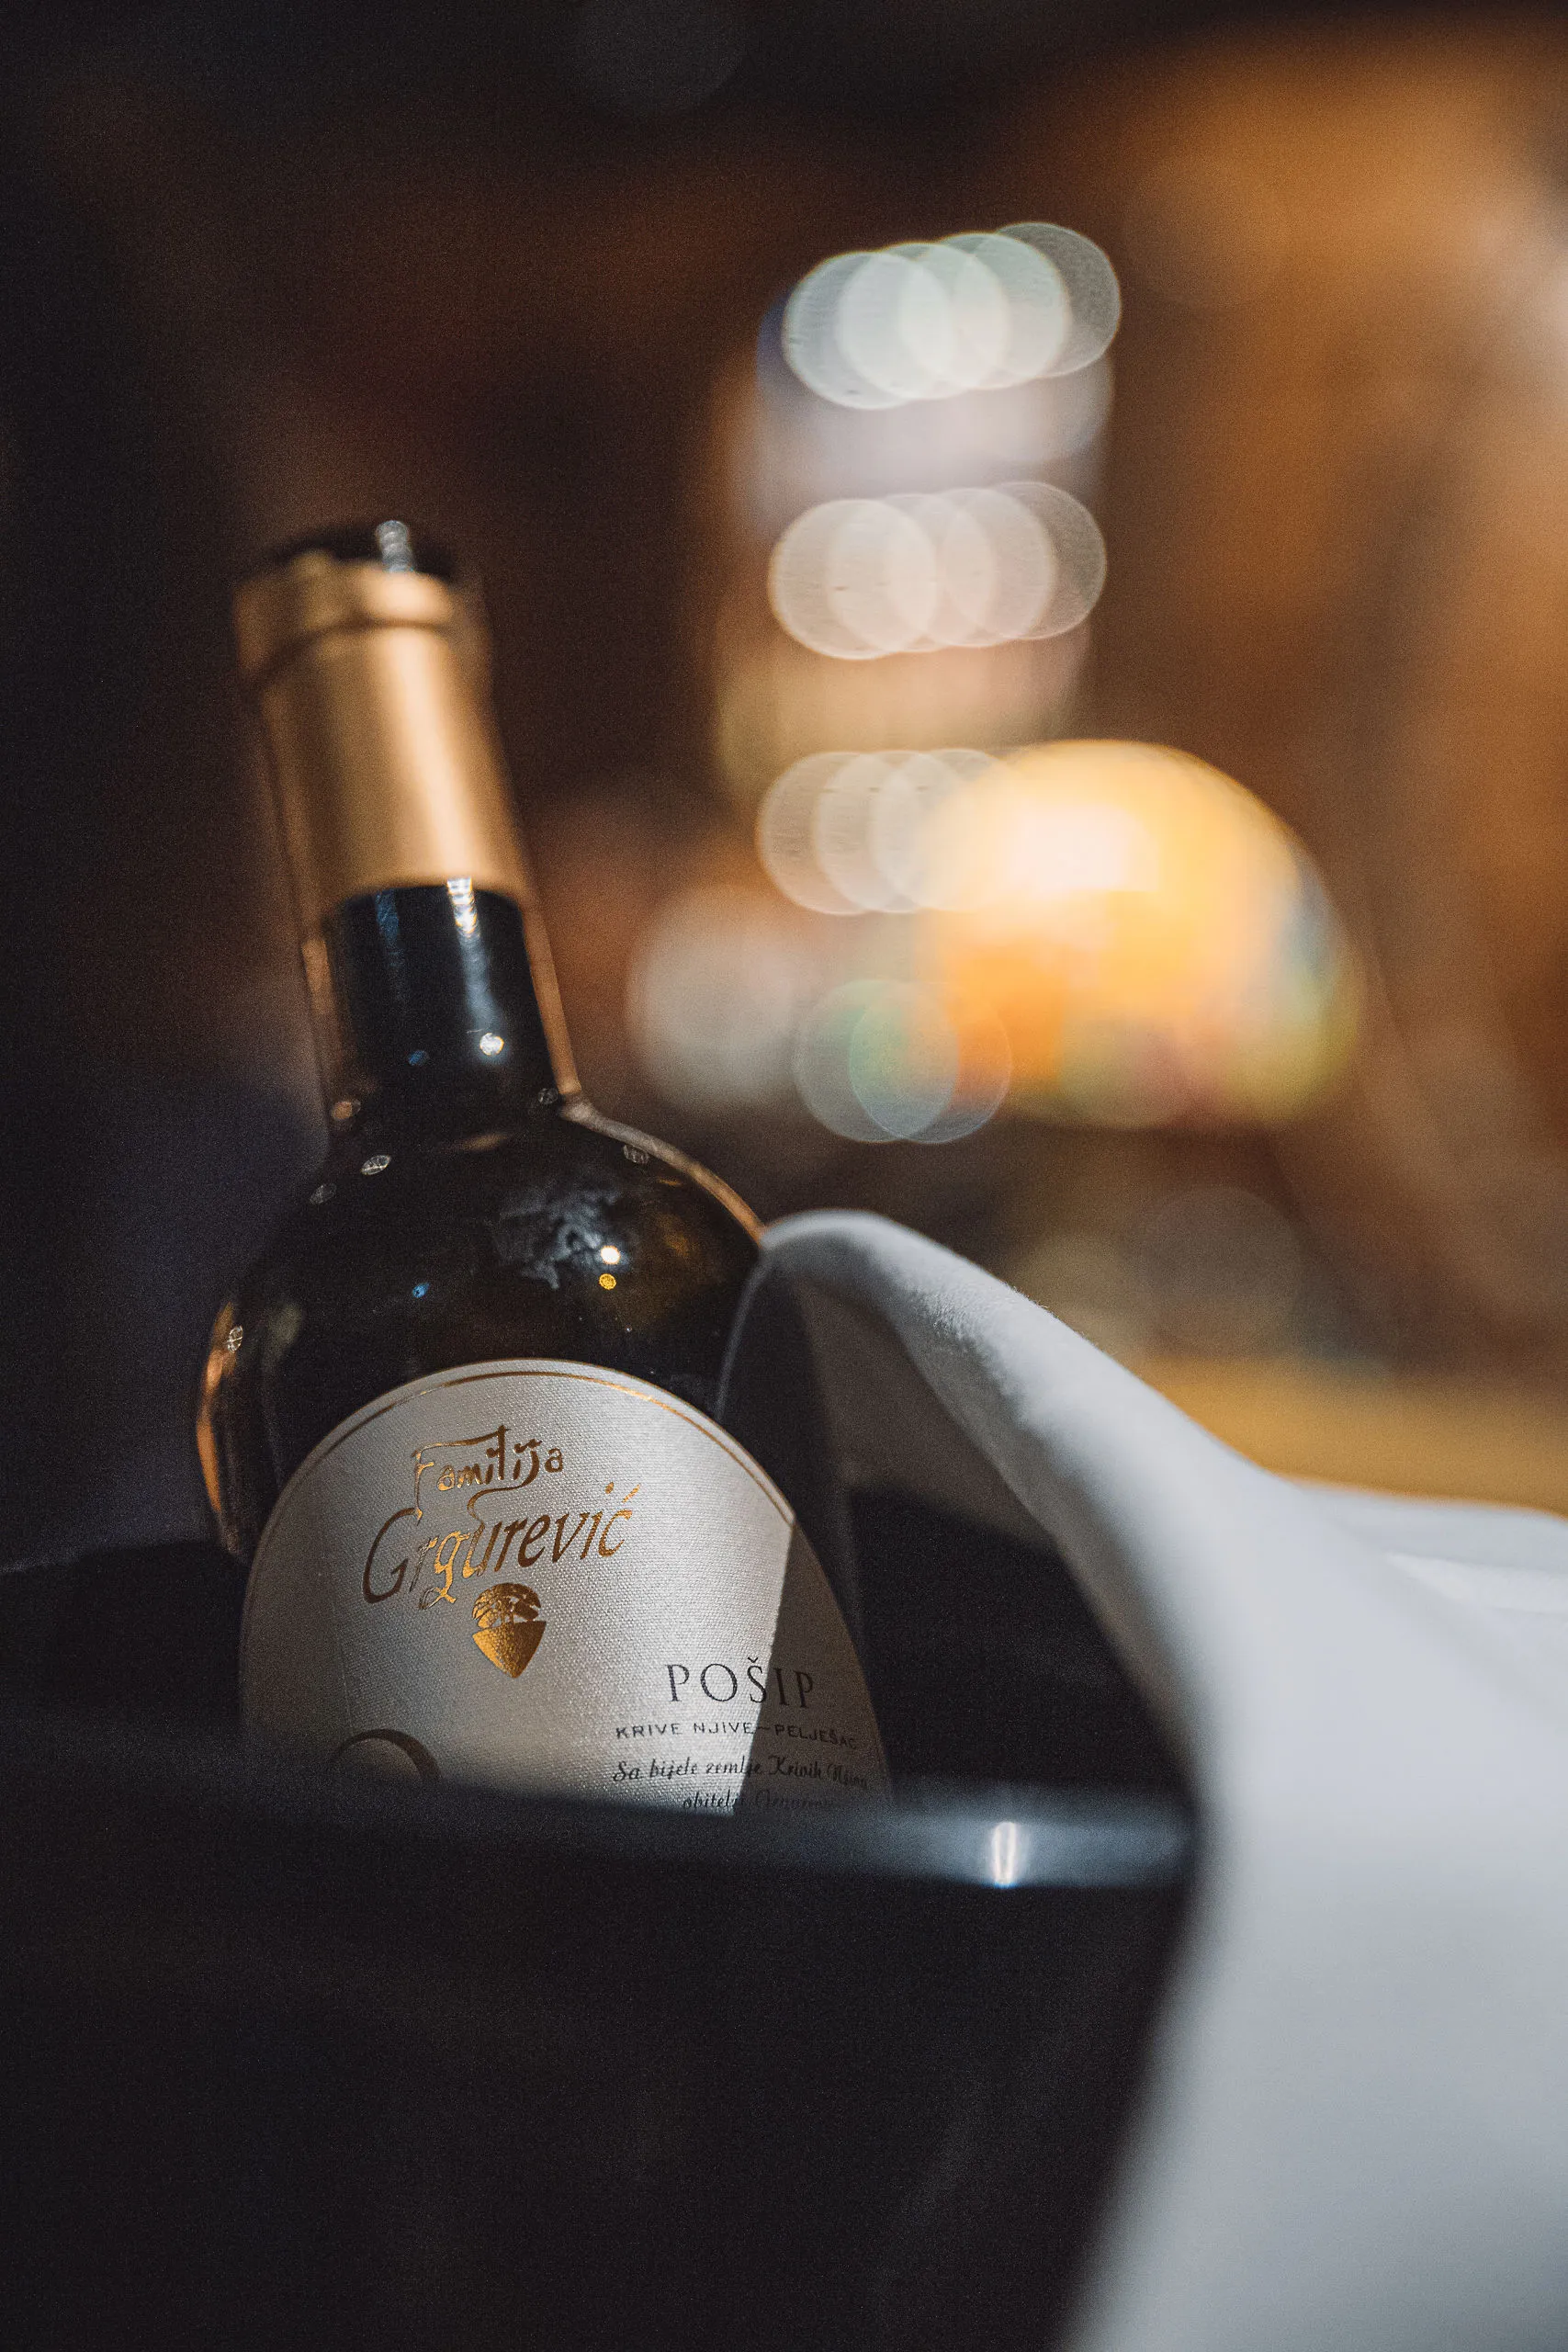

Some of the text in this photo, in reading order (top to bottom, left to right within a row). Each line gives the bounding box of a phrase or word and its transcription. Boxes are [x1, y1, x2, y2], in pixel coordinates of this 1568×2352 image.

[412, 1425, 564, 1521] Familija
[362, 1482, 640, 1609] Grgurević
[665, 1657, 814, 1708] POŠIP
[615, 1722, 683, 1739] KRIVE
[613, 1759, 641, 1781] Sa
[649, 1756, 698, 1781] bijele
